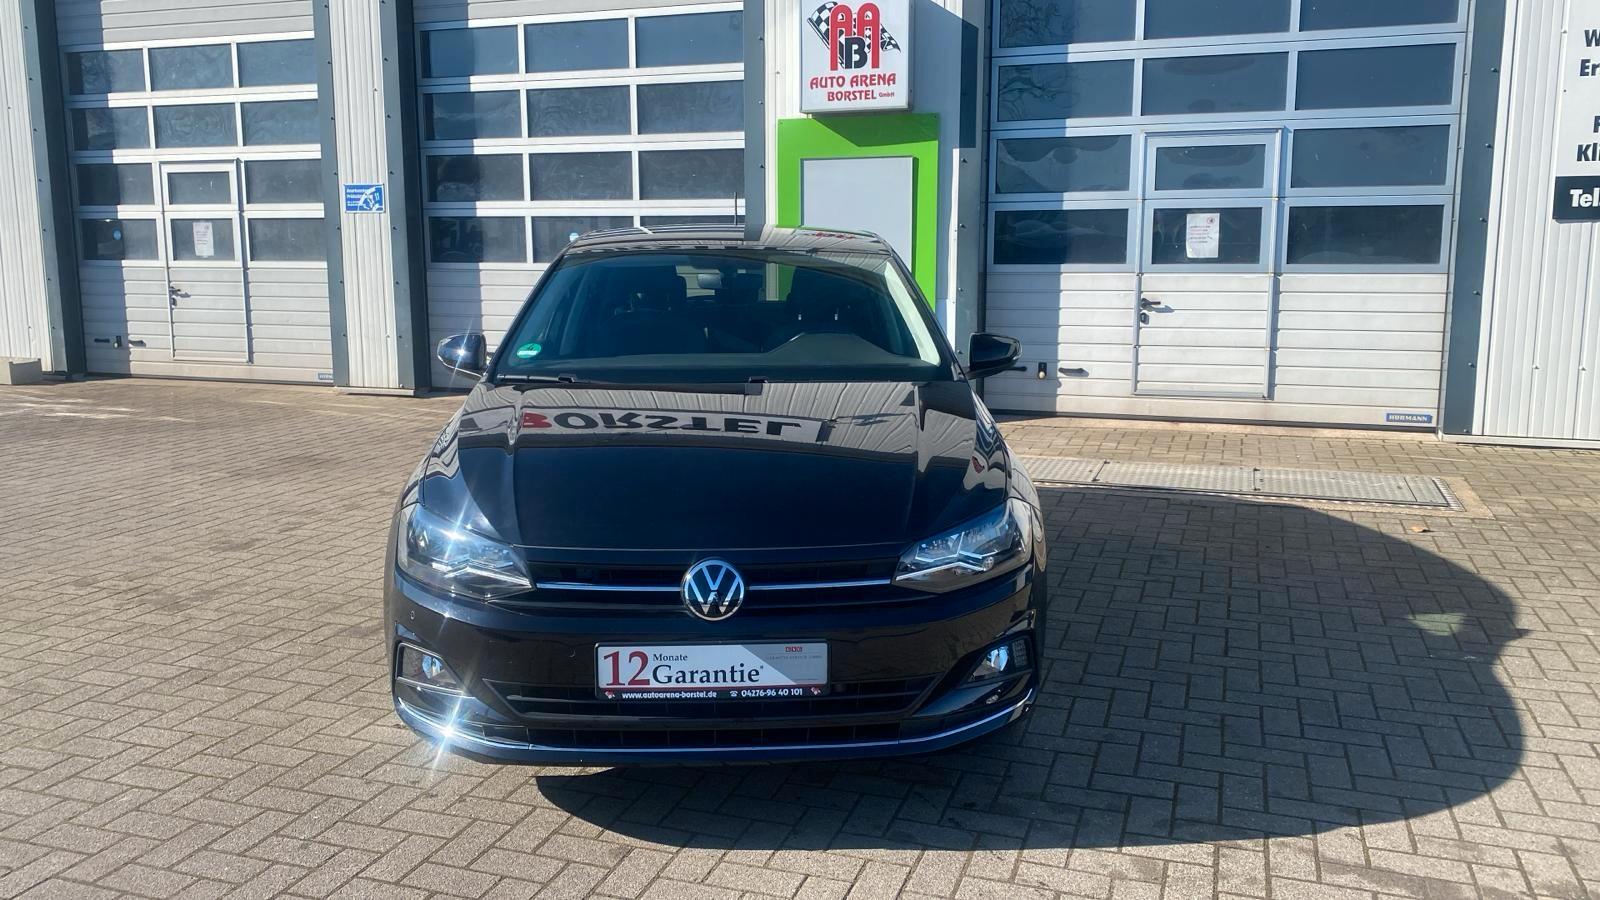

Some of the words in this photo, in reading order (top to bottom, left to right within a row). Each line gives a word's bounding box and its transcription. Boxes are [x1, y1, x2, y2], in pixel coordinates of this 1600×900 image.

[810, 76, 846, 90] AUTO
[850, 73, 896, 88] ARENA
[827, 90, 877, 101] BORSTEL
[603, 650, 651, 686] 12
[653, 653, 688, 661] Monate
[622, 691, 717, 699] www.autoarena-borstel.de
[741, 689, 776, 697] 04276-96
[778, 688, 788, 696] 40
[791, 688, 803, 696] 101
